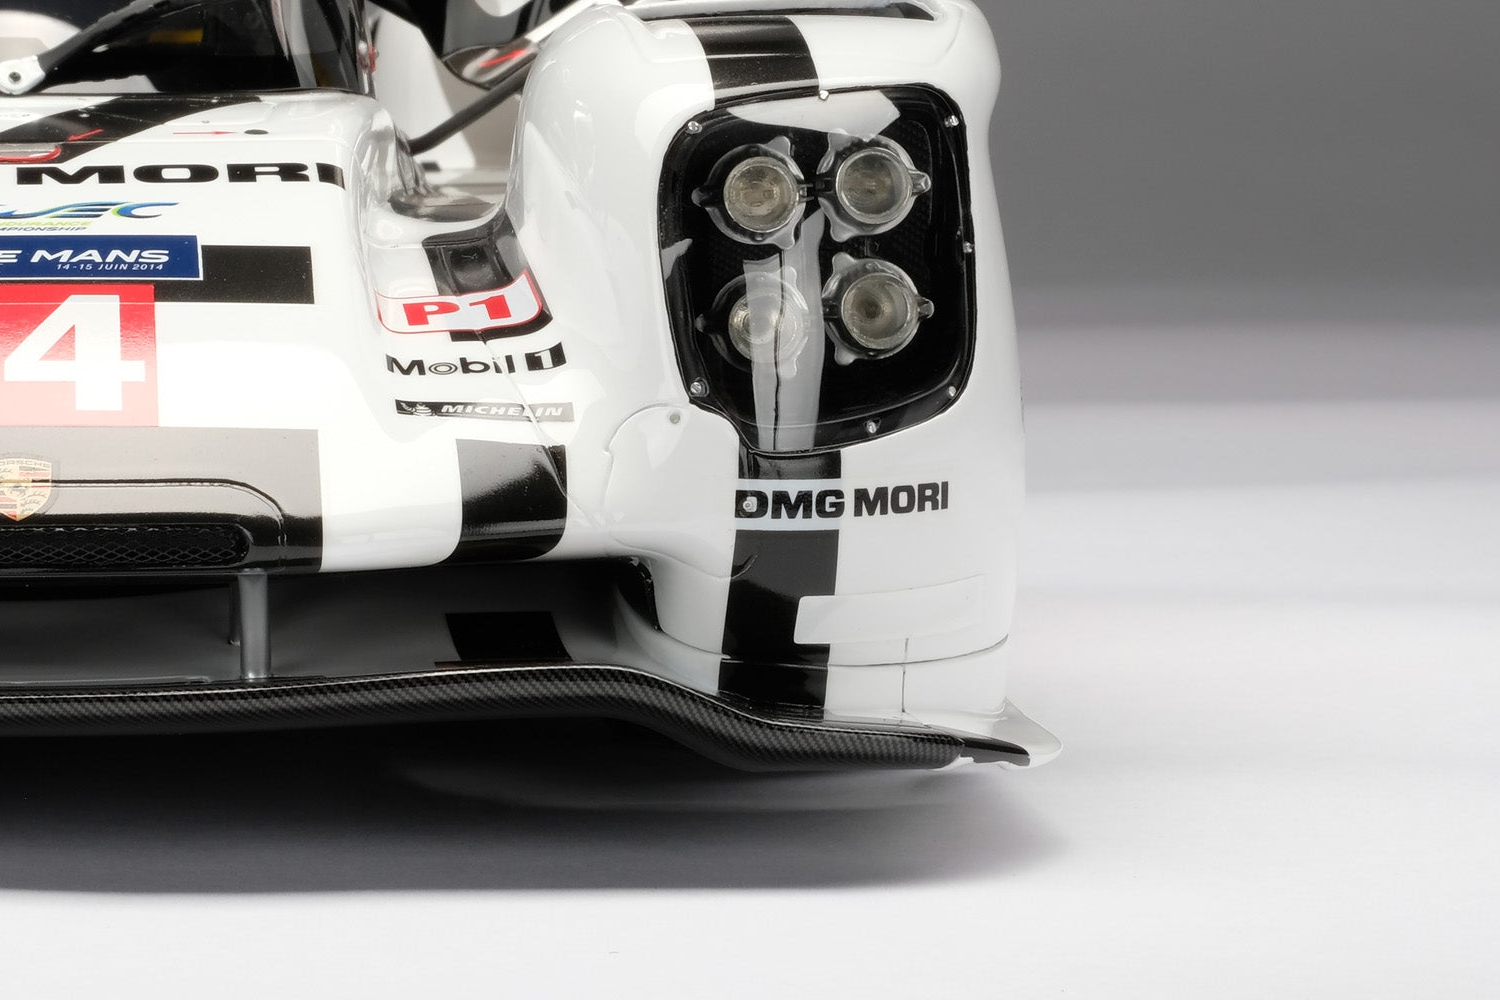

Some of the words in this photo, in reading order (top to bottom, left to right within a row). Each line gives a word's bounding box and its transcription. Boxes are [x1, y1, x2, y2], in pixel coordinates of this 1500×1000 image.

[16, 162, 346, 190] MORI
[30, 249, 170, 264] MANS
[56, 263, 93, 271] 14-15
[98, 263, 128, 271] JUIN
[132, 263, 164, 271] 2014
[402, 294, 512, 326] P1
[385, 353, 516, 376] Mobil
[440, 404, 564, 417] MICHELIN
[735, 489, 845, 519] DMG
[853, 481, 949, 517] MORI
